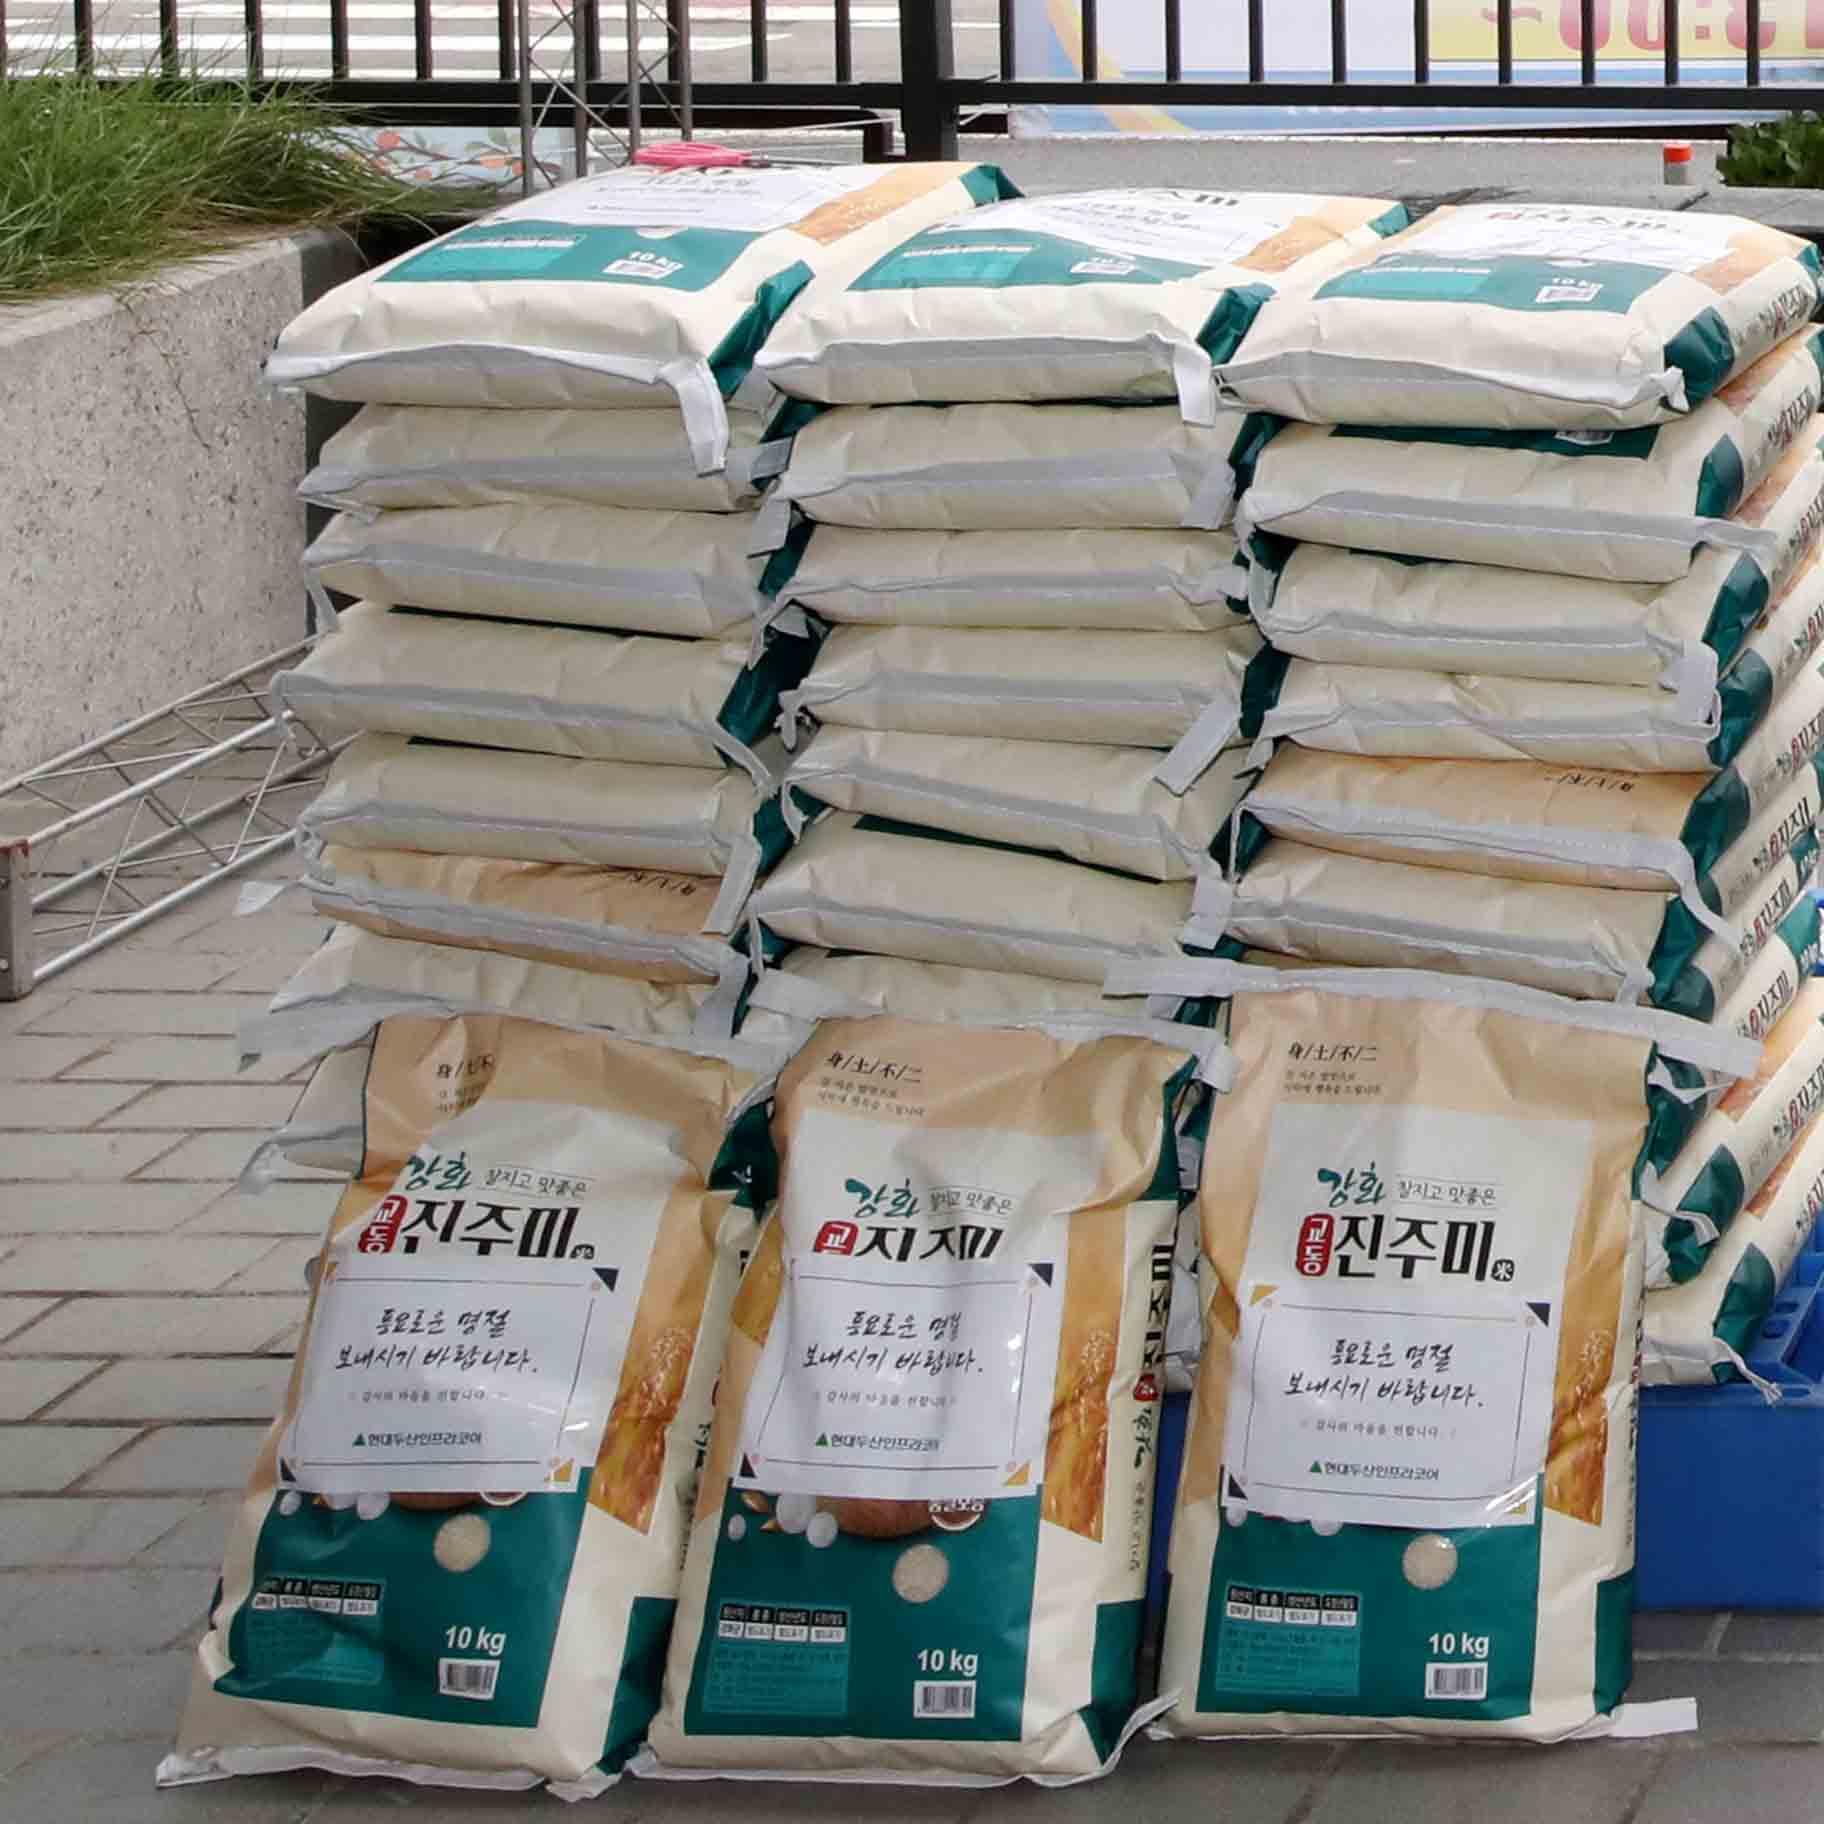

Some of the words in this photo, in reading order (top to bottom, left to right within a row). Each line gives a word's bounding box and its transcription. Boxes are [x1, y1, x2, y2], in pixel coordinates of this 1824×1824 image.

[404, 1150, 472, 1191] 강화
[1317, 1161, 1386, 1208] 강화
[844, 1178, 921, 1219] 강화
[400, 1199, 582, 1259] 진주미
[1333, 1214, 1498, 1281] 진주미
[375, 1308, 446, 1336] 풍요로운
[458, 1308, 512, 1338] 명절
[847, 1311, 918, 1338] 풍요로운
[336, 1344, 414, 1371] 보내시기
[803, 1346, 888, 1371] 보내시기
[1329, 1339, 1396, 1367] 풍요로운
[1405, 1342, 1454, 1373] 명절
[1284, 1372, 1371, 1399] 보내시기
[444, 1625, 472, 1650] 10
[477, 1627, 507, 1656] kg
[1428, 1632, 1456, 1655] 10
[1459, 1633, 1490, 1660] kg
[917, 1649, 945, 1673] 10
[949, 1649, 979, 1676] kg
